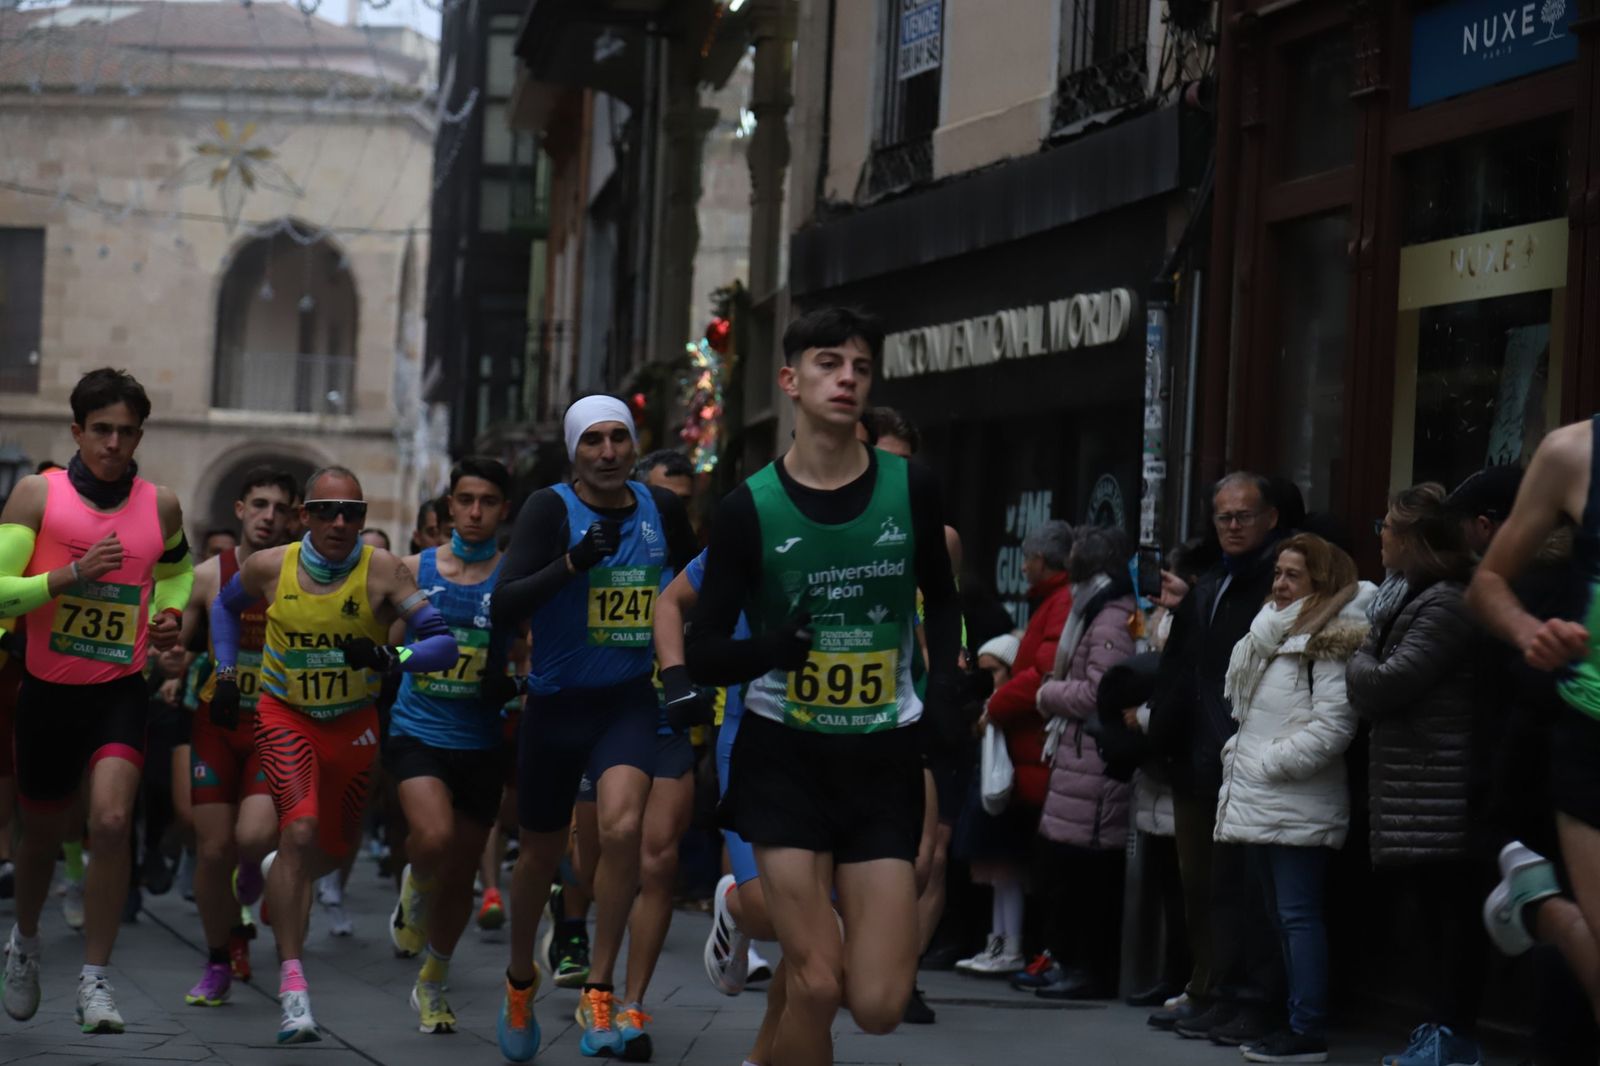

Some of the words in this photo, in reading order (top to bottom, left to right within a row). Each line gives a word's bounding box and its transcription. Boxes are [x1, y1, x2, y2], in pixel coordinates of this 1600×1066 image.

[902, 6, 940, 43] VENDE
[1462, 2, 1536, 55] NUXE
[1049, 287, 1132, 355] WORLD
[807, 558, 906, 585] universidad
[595, 589, 654, 621] 1247
[809, 585, 826, 597] de
[827, 582, 864, 601] león
[61, 603, 126, 641] 735
[611, 632, 634, 641] CAJA
[72, 643, 95, 654] CAJA
[96, 646, 128, 658] RURAL
[285, 632, 353, 648] TEAM
[297, 670, 348, 700] 1171
[794, 661, 883, 705] 695
[816, 713, 848, 726] CAJA
[851, 711, 892, 727] RURAL
